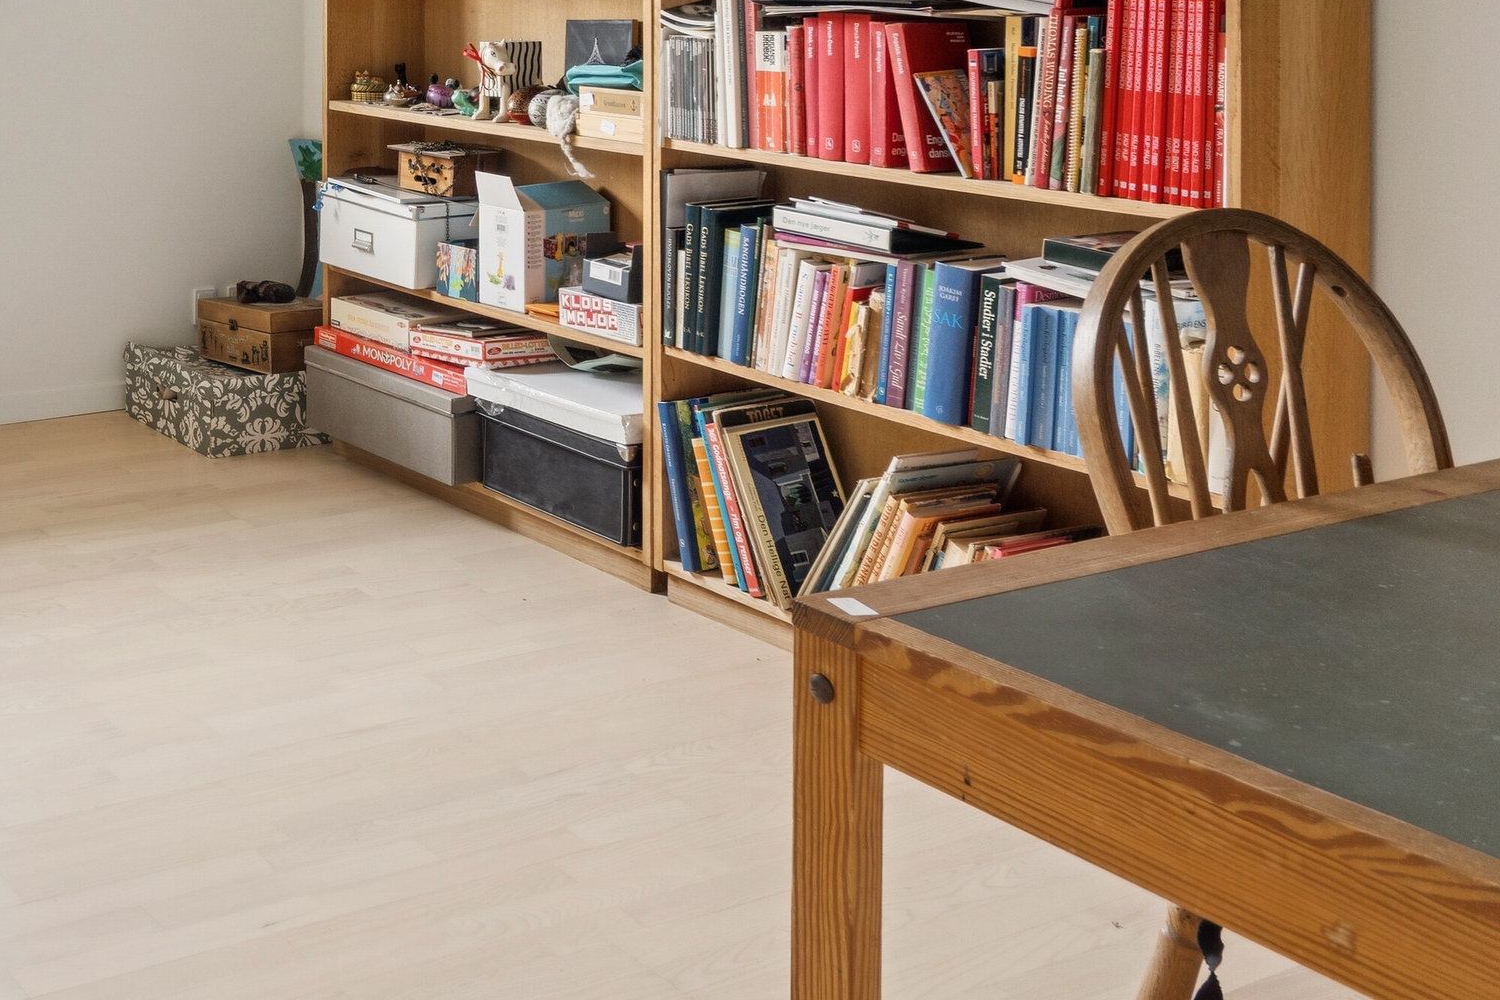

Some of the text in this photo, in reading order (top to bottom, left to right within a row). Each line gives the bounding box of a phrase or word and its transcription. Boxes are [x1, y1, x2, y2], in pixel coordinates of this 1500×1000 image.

[1043, 15, 1058, 108] THOMAS WINDING
[1055, 66, 1066, 123] Jul hele året
[1217, 62, 1225, 102] MADVARER
[782, 216, 831, 232] Den nye jæger
[684, 272, 692, 309] LEKSIKON
[738, 237, 749, 315] SANGHÅNDBOGEN
[939, 284, 962, 297] JOAKIM
[561, 294, 613, 312] KLODS
[698, 276, 706, 313] LEKSIKON
[982, 290, 997, 331] Studier
[566, 310, 619, 331] MAJOR
[809, 302, 817, 324] FØRSTE
[932, 309, 964, 329] SAK
[804, 325, 814, 354] SALMEBOG
[814, 326, 823, 356] SALMEBOG
[890, 312, 907, 389] Sandt Liv Gud
[362, 346, 412, 372] MONOPOLY
[978, 339, 993, 379] Stadier
[708, 428, 753, 576] 365 Godnatsange rim og remser
[880, 502, 893, 525] RIDE
[757, 515, 790, 600] Den Hellige Nat
[869, 531, 883, 556] RIDE
